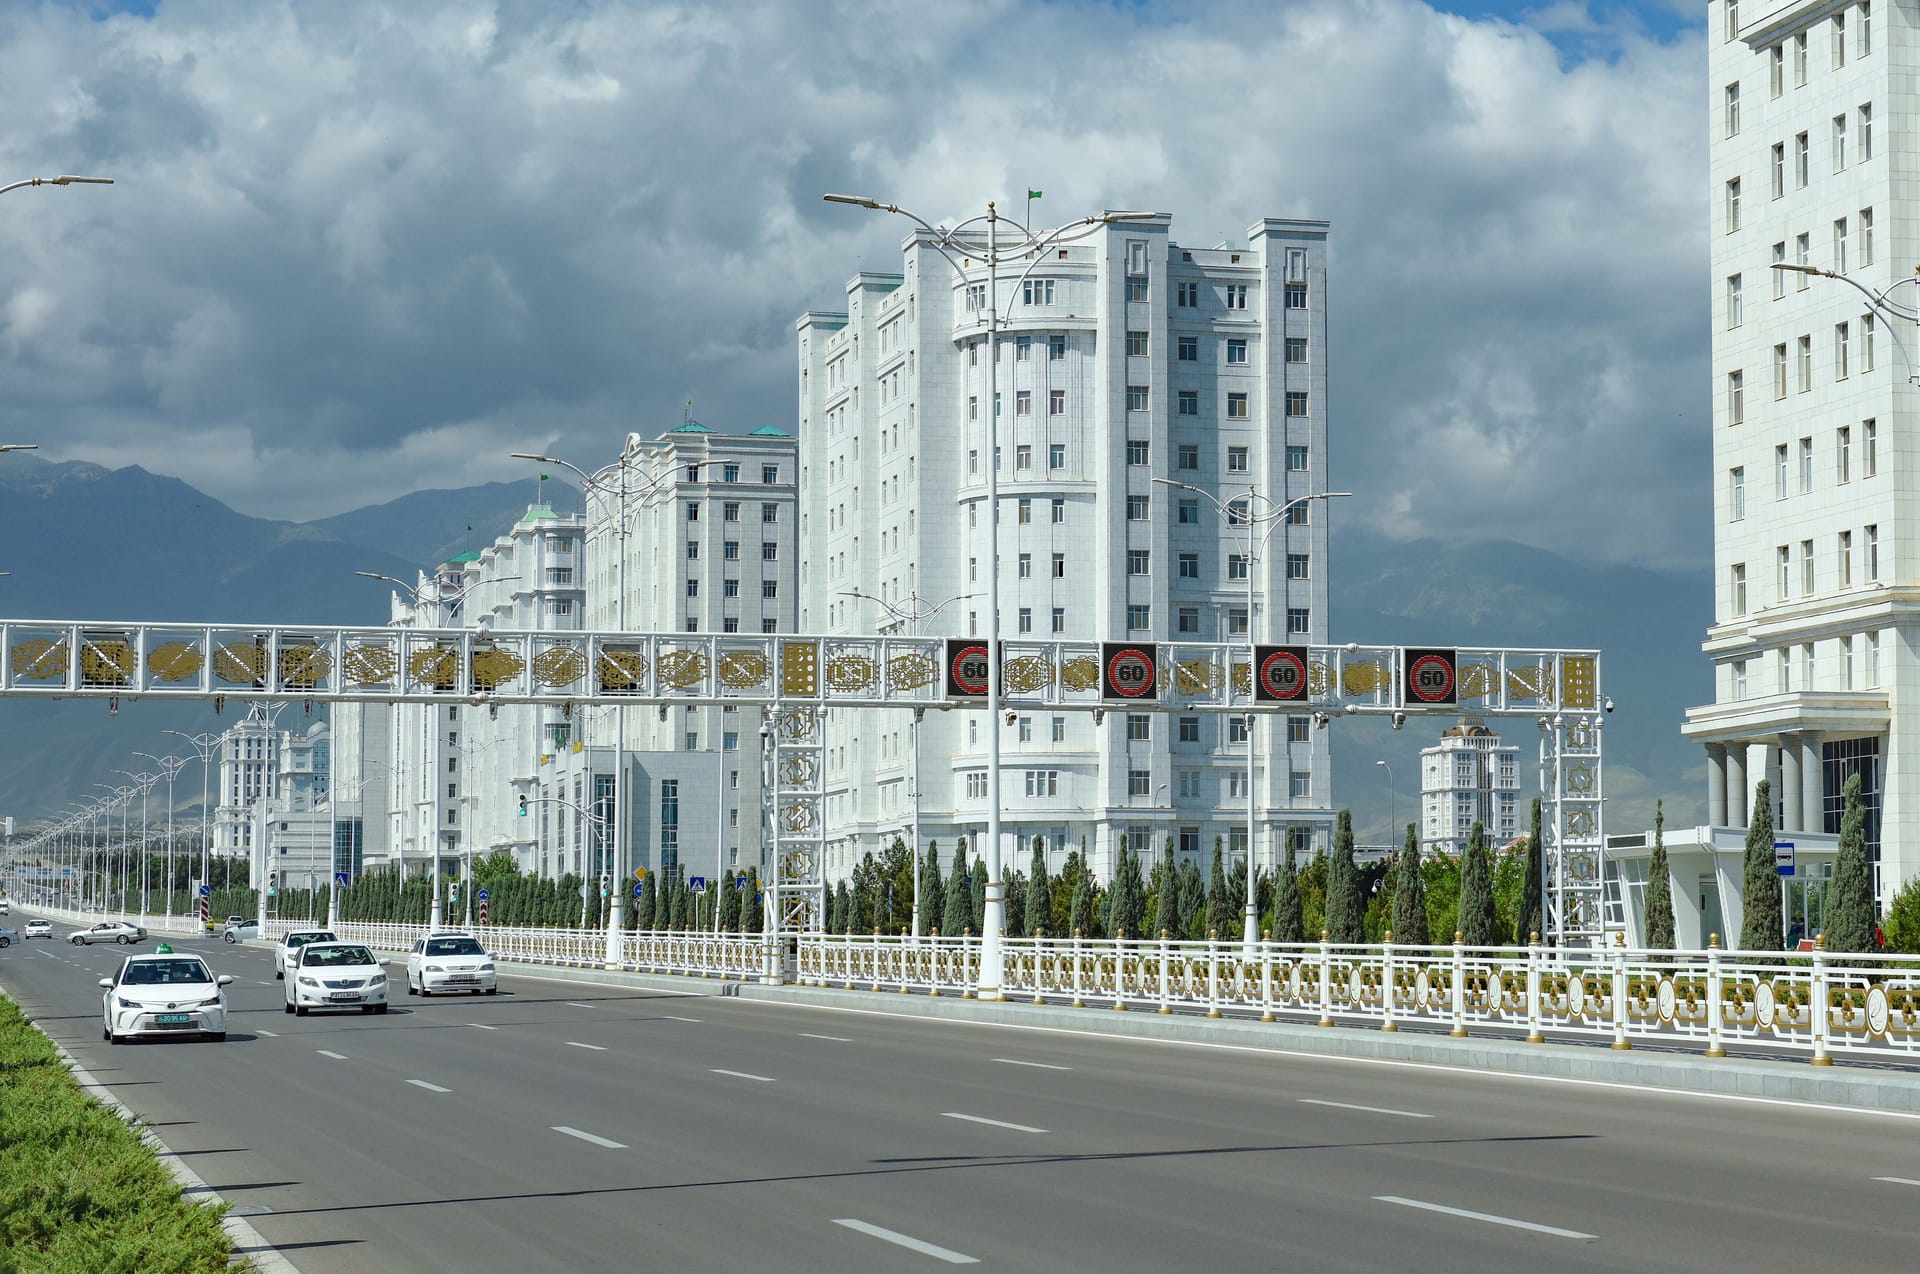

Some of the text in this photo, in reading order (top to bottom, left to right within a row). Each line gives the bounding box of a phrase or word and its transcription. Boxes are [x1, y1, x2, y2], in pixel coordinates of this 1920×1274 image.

[963, 662, 988, 678] 60
[1118, 665, 1145, 682] 60
[1270, 667, 1295, 684] 60
[1419, 670, 1444, 687] 60
